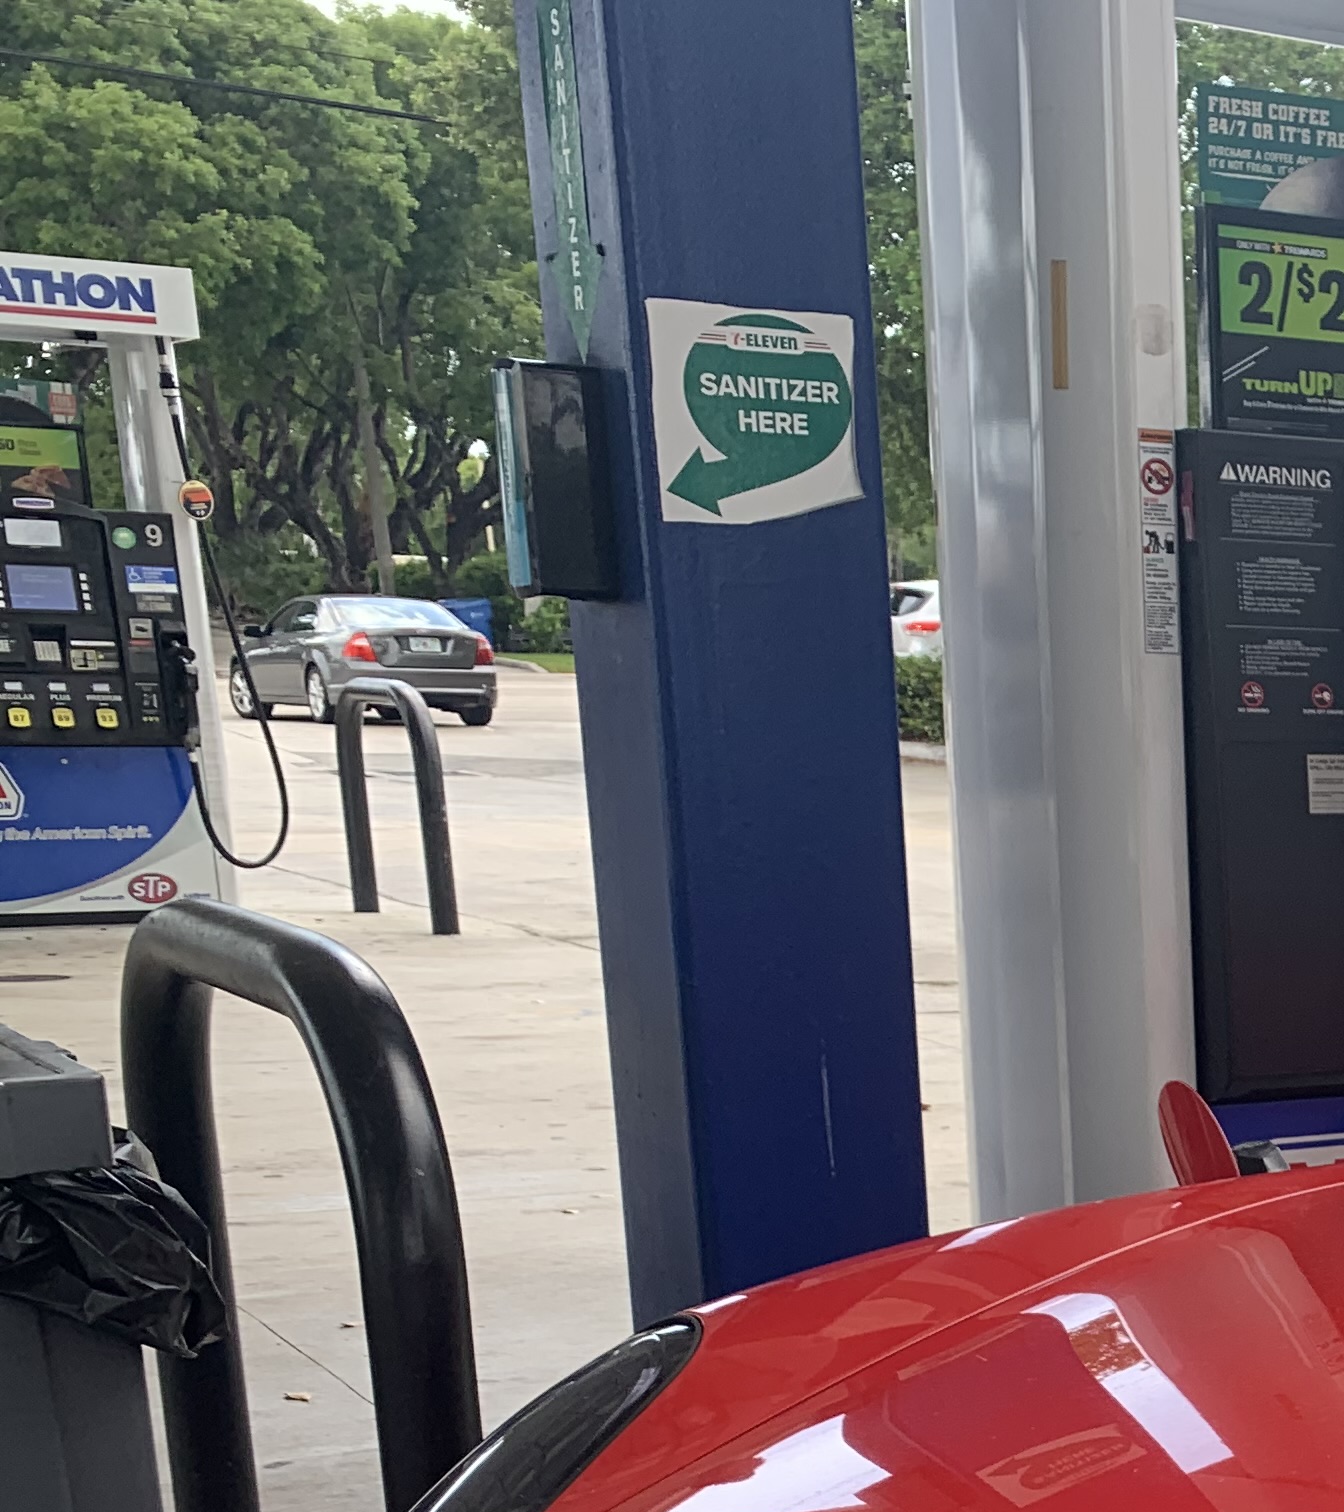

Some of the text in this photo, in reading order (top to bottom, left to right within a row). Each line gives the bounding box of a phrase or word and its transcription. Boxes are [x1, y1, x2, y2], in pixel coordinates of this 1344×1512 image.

[1208, 95, 1330, 126] FRESH COFFEE
[1208, 117, 1247, 137] 24/7
[1252, 122, 1275, 140] OR
[1279, 125, 1311, 144] IT'S
[549, 7, 585, 311] SANITIZER
[1254, 150, 1263, 161] A
[1264, 152, 1294, 164] COFFEE
[700, 372, 840, 404] SANITIZER
[737, 409, 810, 436] HERE
[1236, 463, 1332, 489] WARNING
[144, 523, 163, 547] 9
[31, 826, 106, 840] American
[132, 876, 171, 899] STP
